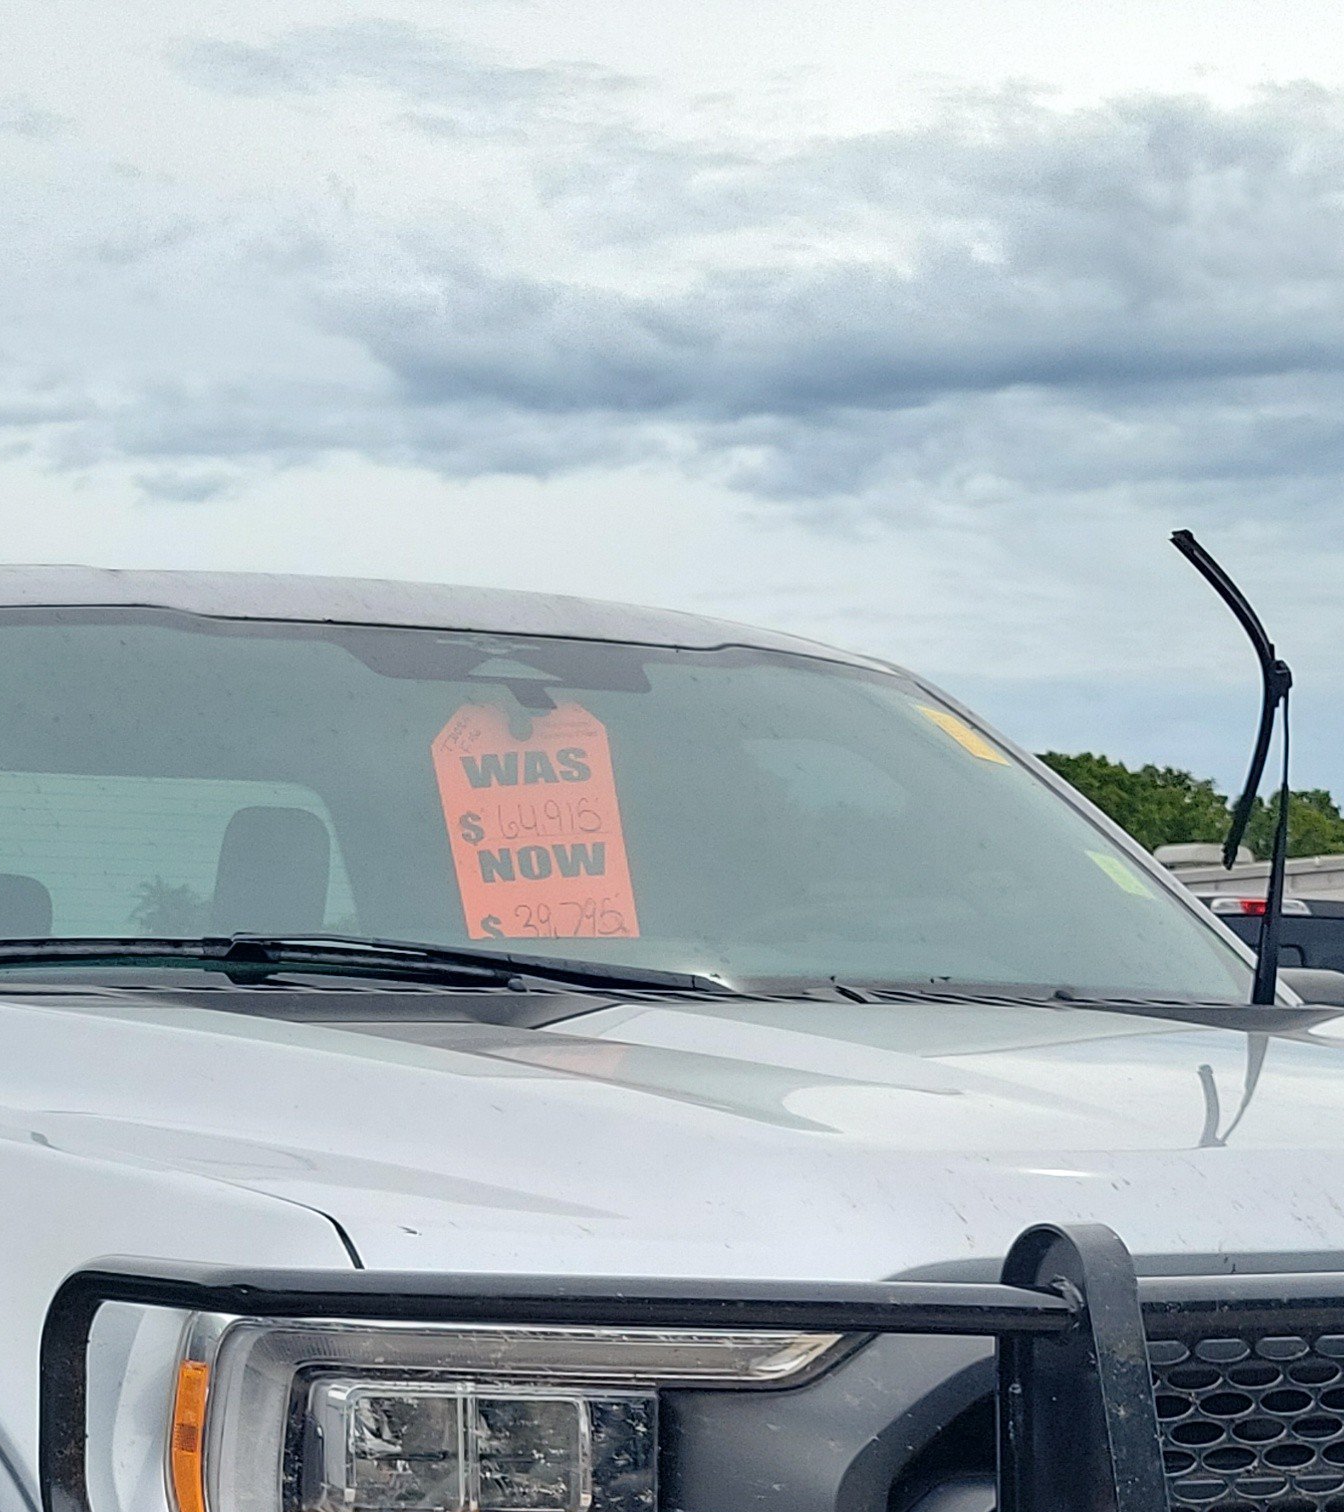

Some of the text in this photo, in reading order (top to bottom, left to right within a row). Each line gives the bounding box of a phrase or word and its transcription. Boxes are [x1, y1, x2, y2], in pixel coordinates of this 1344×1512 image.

[459, 748, 591, 789] WAS
[459, 811, 485, 846] $
[477, 842, 607, 884] NOW
